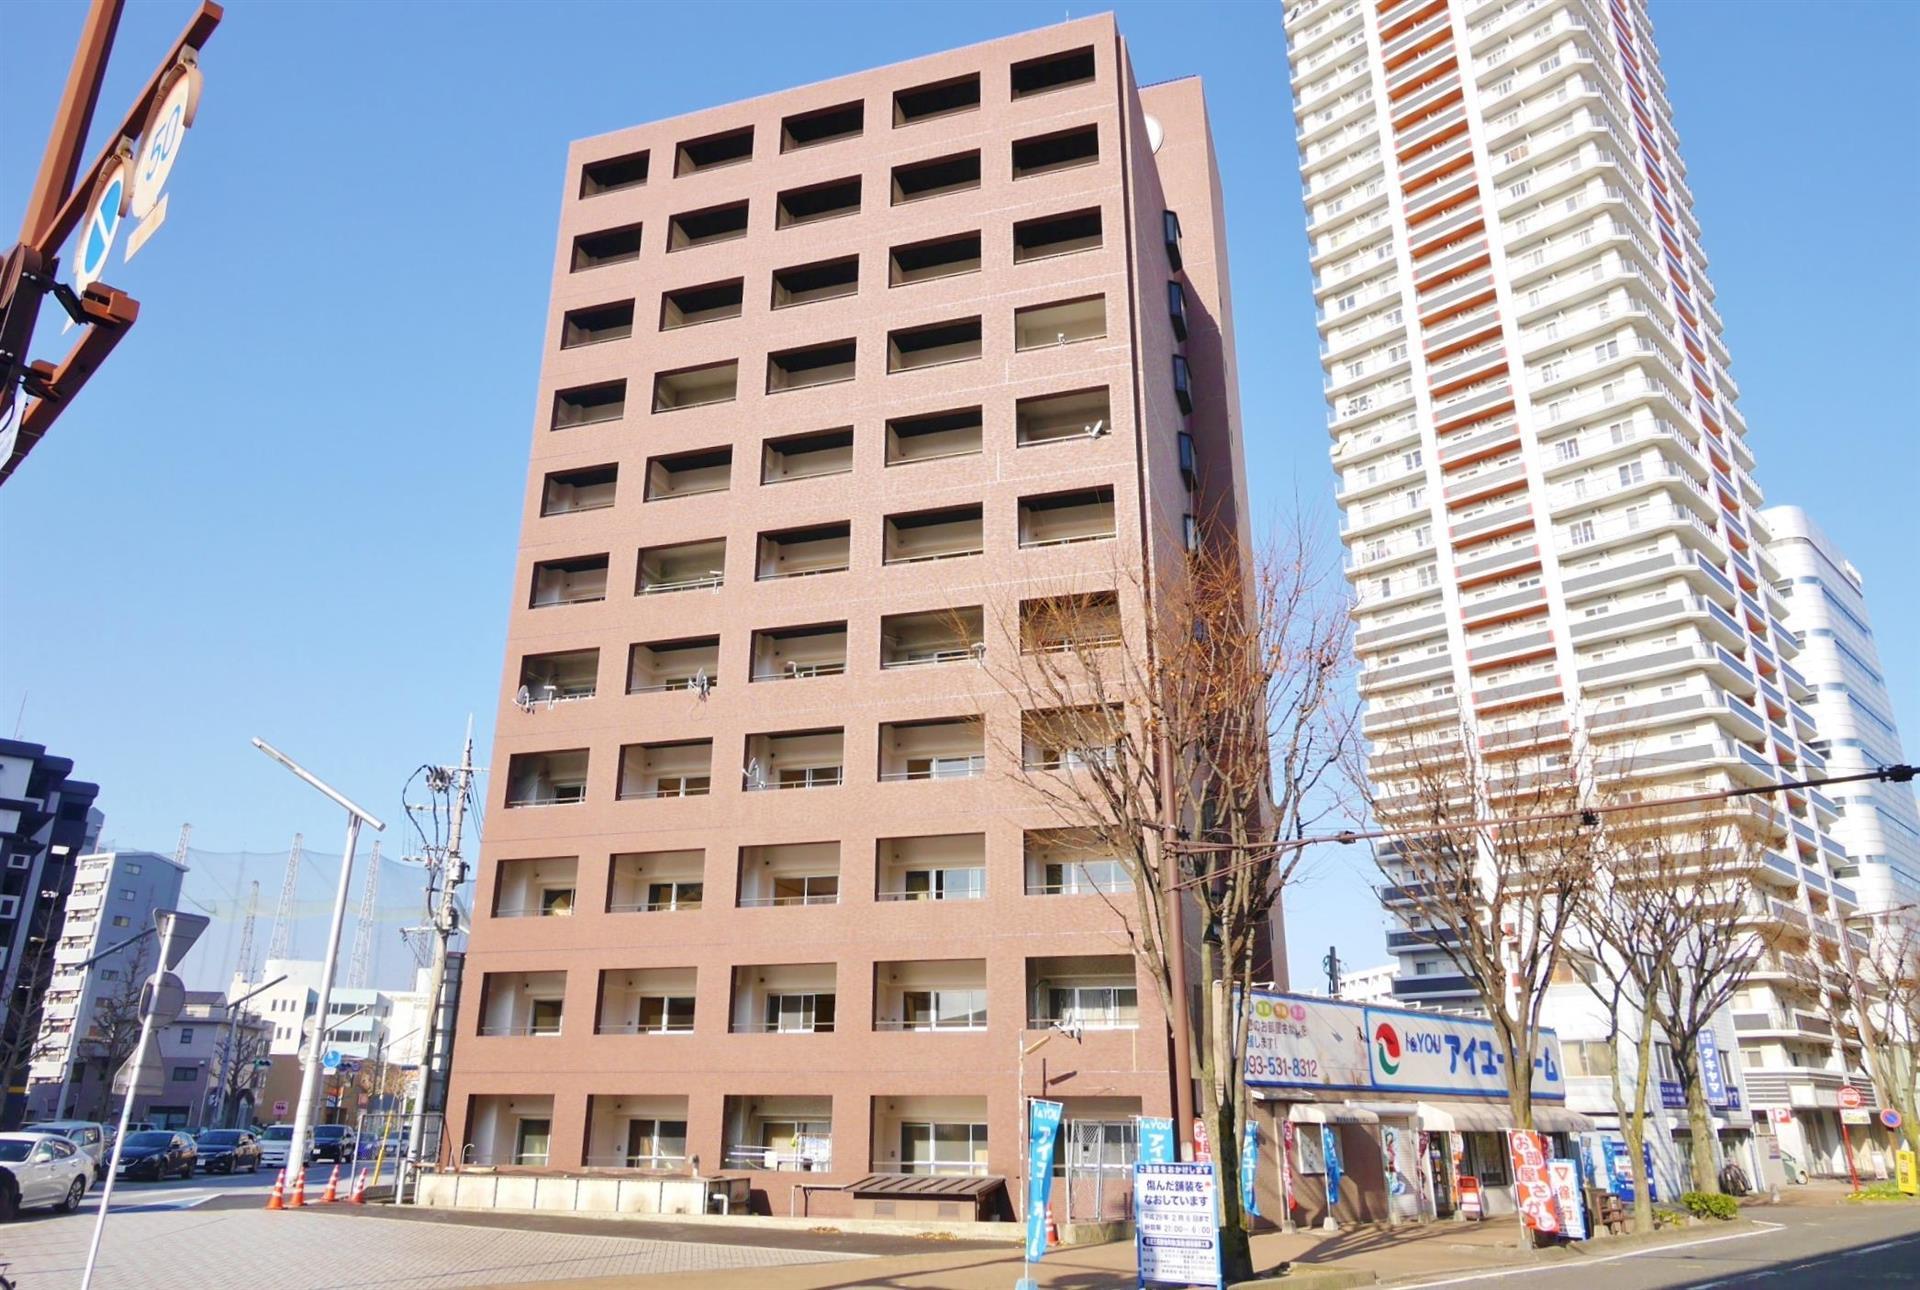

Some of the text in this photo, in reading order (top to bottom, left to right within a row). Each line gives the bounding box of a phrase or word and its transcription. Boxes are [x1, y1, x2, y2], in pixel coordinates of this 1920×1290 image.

[146, 104, 181, 180] 50
[1444, 1034, 1559, 1082] アイユーーム
[1703, 1048, 1719, 1093] タキヤマ
[1148, 1133, 1165, 1163] アイ
[1144, 1195, 1208, 1206] なおしています
[1146, 1180, 1204, 1192] 傷んだ舗装を
[1514, 1135, 1552, 1229] お部屋さがし
